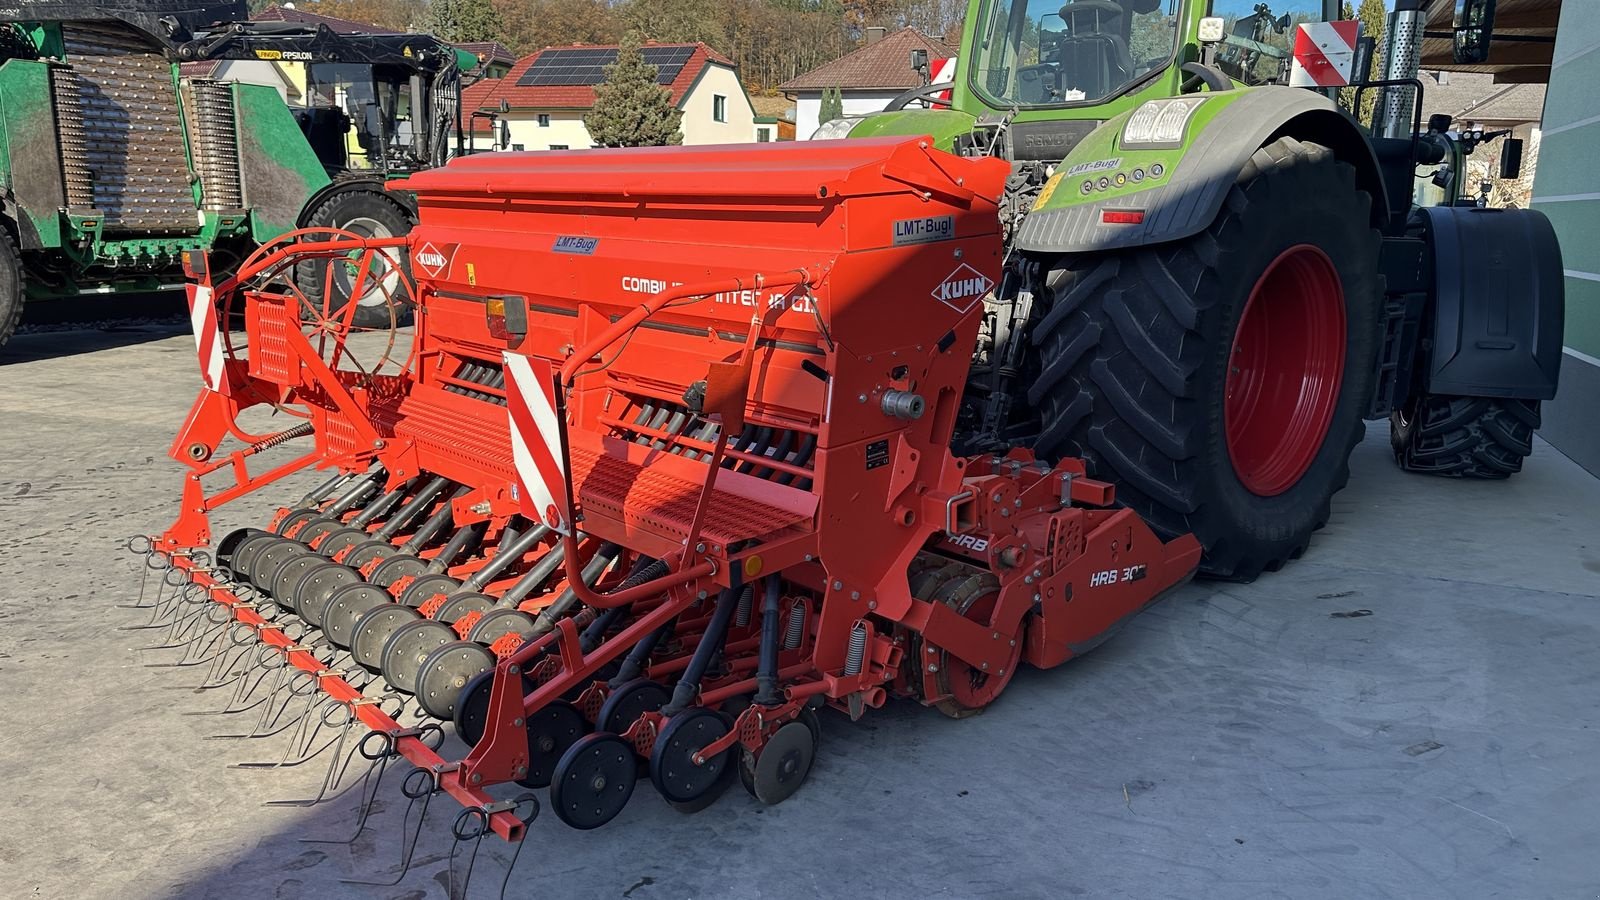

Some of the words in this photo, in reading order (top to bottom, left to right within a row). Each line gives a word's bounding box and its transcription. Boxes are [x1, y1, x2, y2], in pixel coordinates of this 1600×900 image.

[1024, 132, 1077, 147] FENDT
[1069, 158, 1120, 175] LMT-Bugl
[896, 216, 952, 236] LMT-Bugl
[556, 236, 597, 252] LMT-Bugl
[420, 253, 442, 267] KUHN
[941, 277, 985, 300] KUHN
[948, 534, 988, 552] HRB
[1090, 569, 1118, 587] HRB
[1121, 564, 1146, 582] 30
